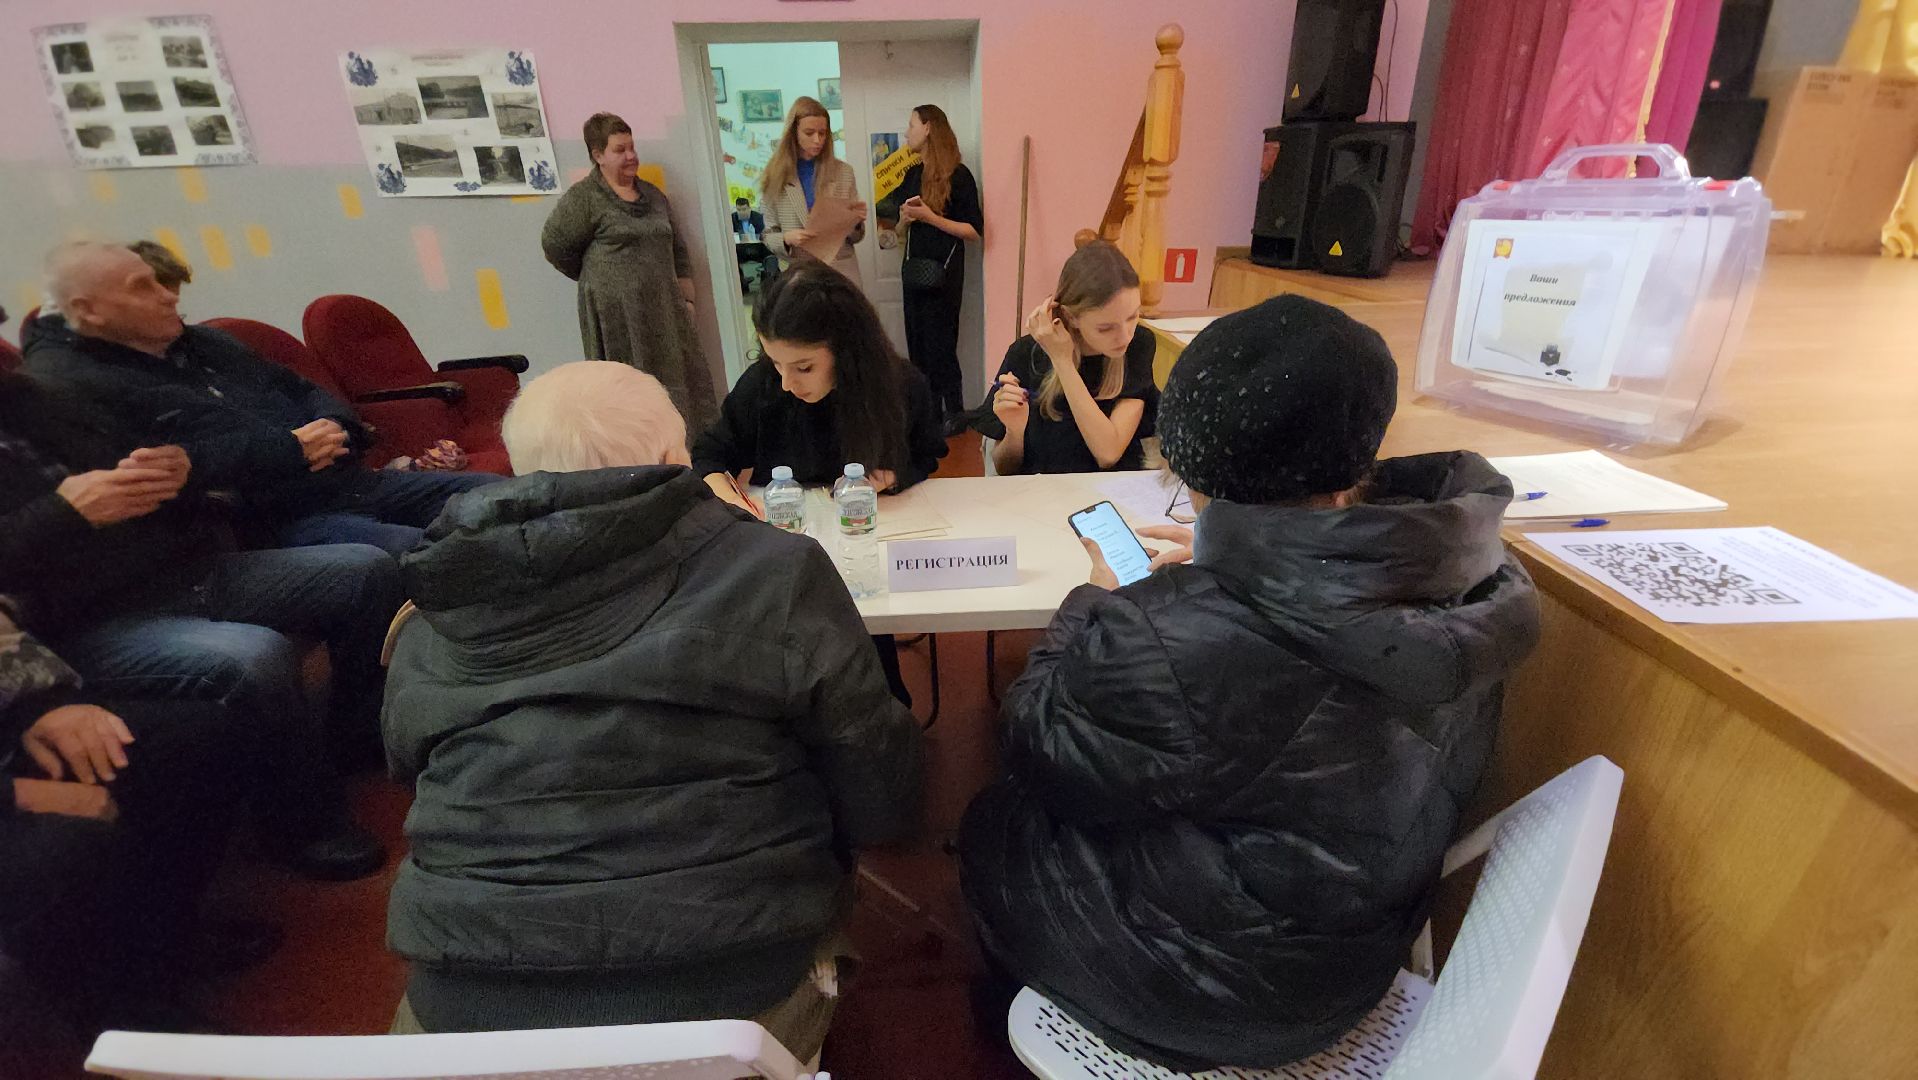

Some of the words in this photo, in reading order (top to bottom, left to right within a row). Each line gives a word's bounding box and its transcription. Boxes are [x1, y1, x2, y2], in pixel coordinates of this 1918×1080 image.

[876, 155, 904, 180] СПИЧКИ
[881, 180, 893, 190] НЕ
[1529, 273, 1559, 285] Ваши
[1503, 292, 1577, 307] предложения
[895, 554, 1008, 571] РЕГИСТРАЦИЯ
